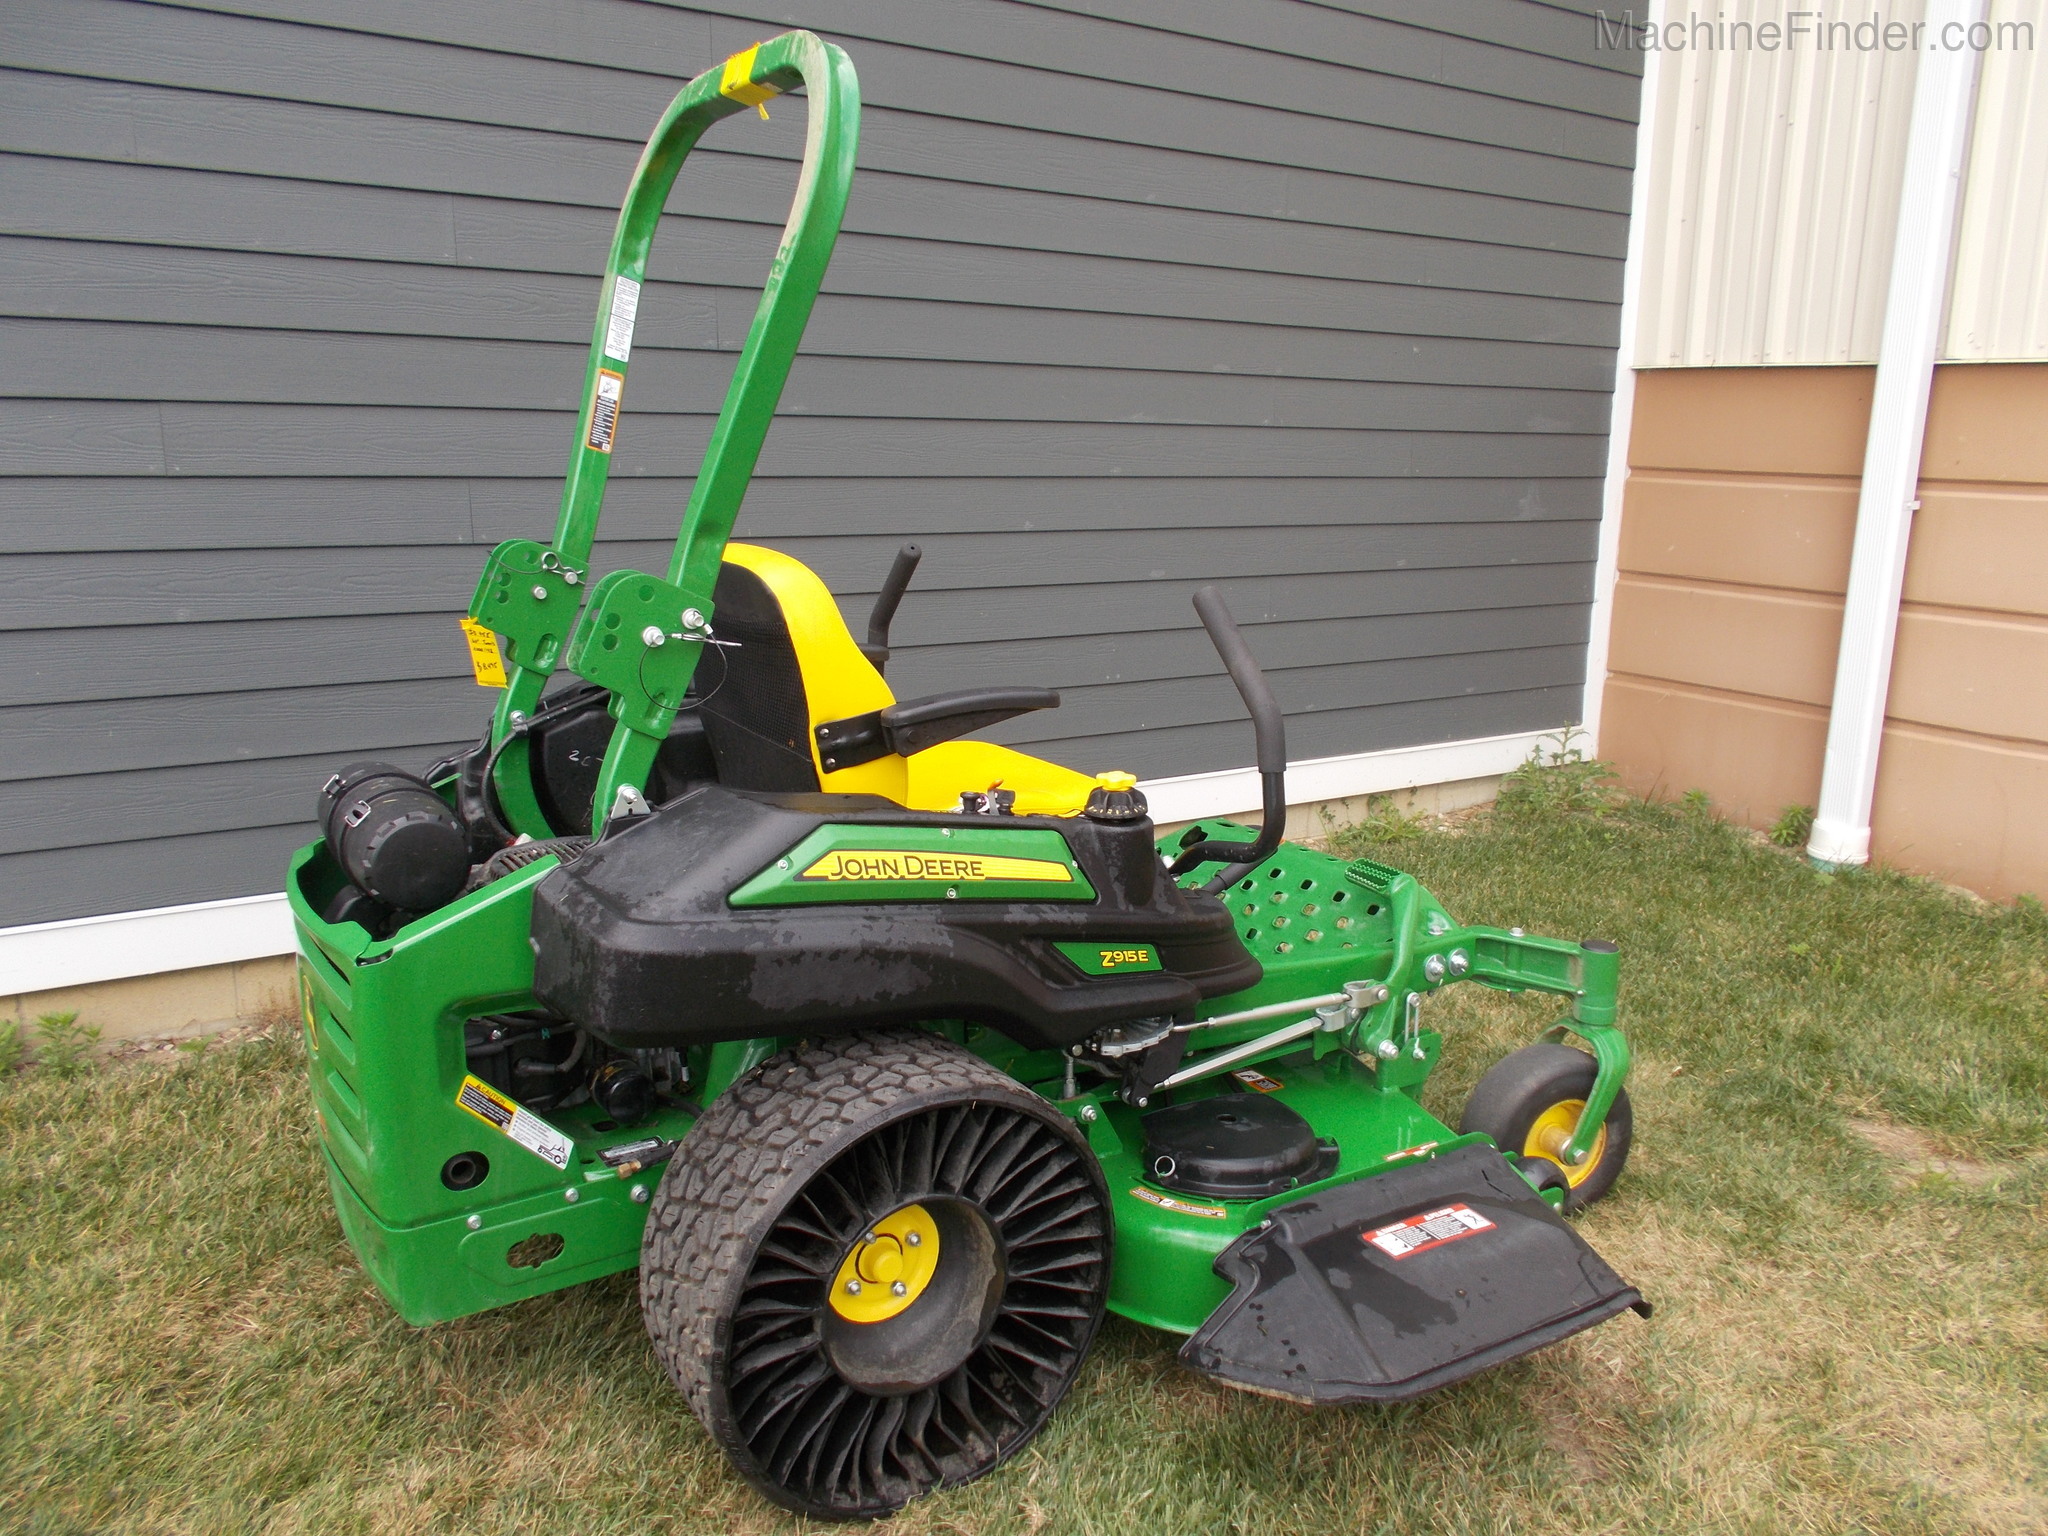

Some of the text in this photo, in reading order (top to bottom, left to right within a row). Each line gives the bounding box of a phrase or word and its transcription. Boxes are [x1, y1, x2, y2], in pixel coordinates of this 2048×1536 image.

[830, 855, 985, 877] JOHN DEERE
[1100, 950, 1149, 968] Z915E
[479, 1086, 507, 1106] CAUTION
